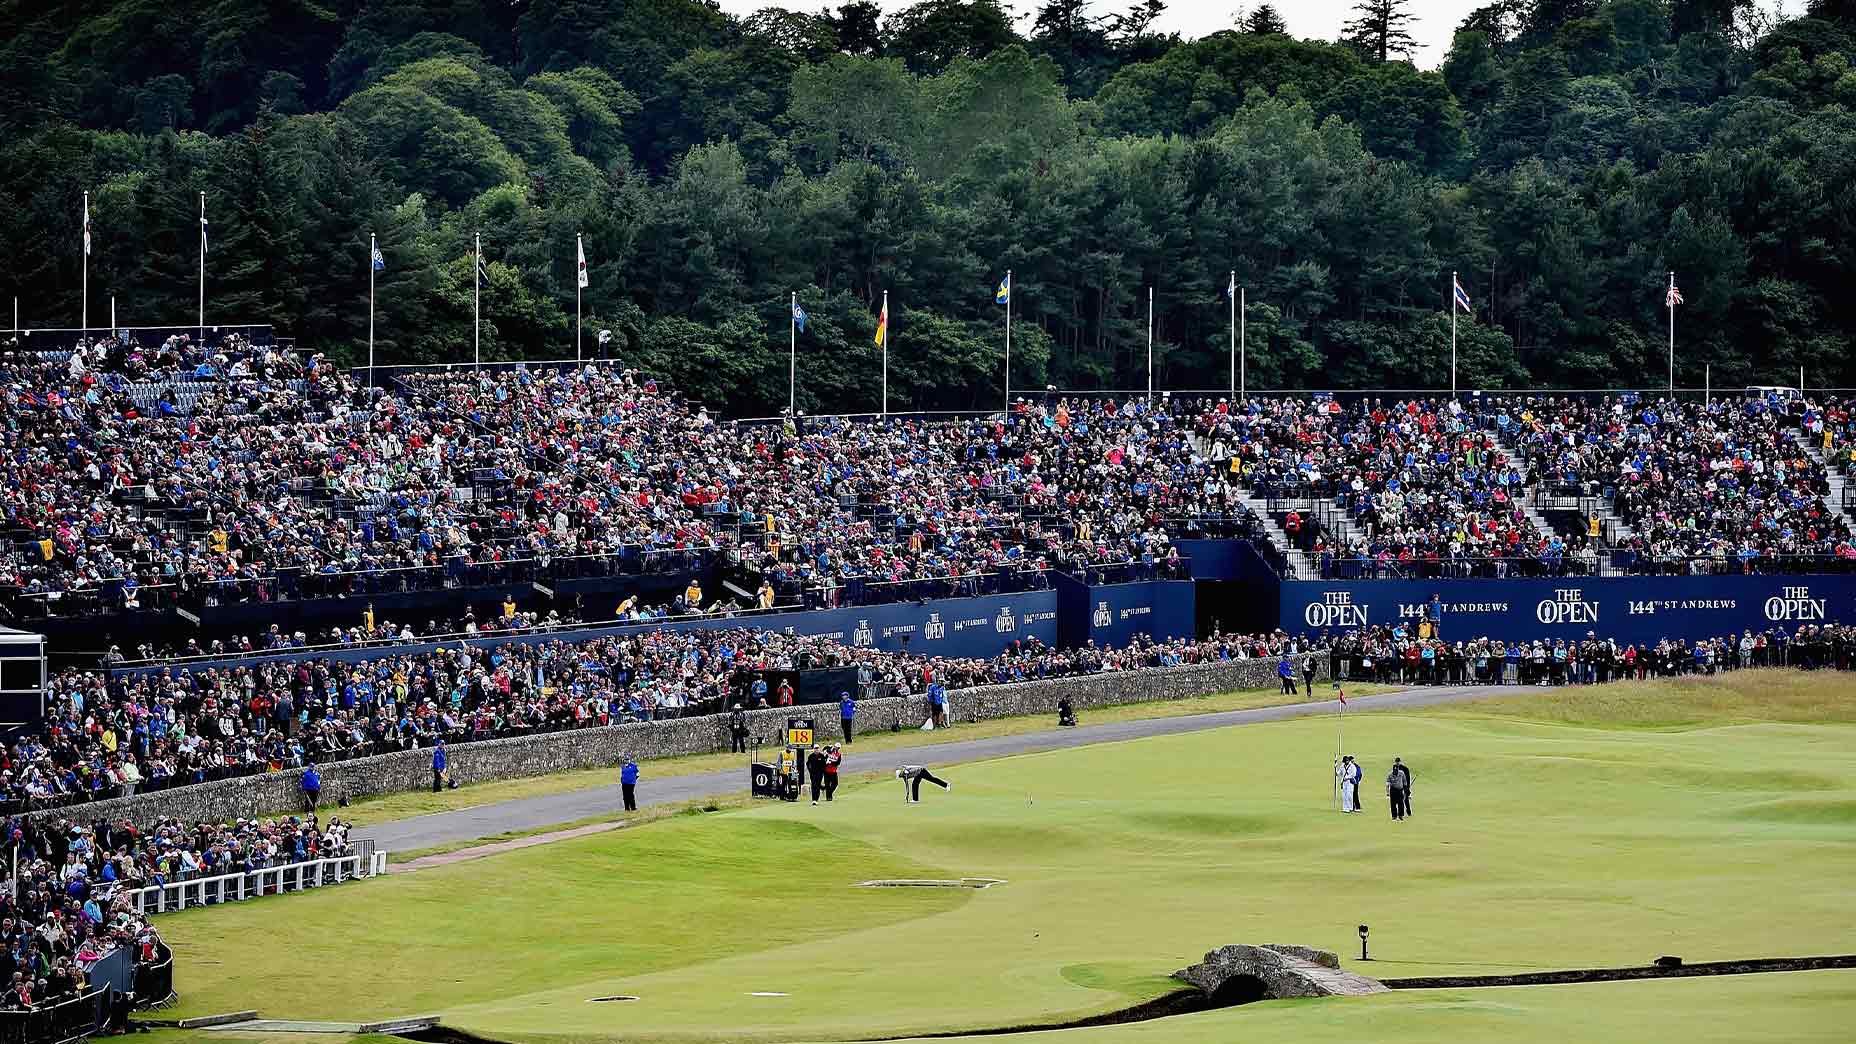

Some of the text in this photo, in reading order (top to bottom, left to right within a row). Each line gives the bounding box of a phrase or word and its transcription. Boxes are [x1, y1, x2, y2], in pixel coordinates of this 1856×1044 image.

[1323, 591, 1351, 605] THE
[1554, 588, 1582, 602] THE
[1782, 586, 1809, 599] THE
[1001, 606, 1011, 616] THE
[1451, 602, 1509, 613] ANDREWS
[1536, 599, 1600, 624] OPEN
[1664, 600, 1678, 609] ST
[1680, 600, 1736, 609] ANDREWS
[1764, 596, 1827, 621] OPEN
[1093, 609, 1112, 628] OPEN
[1305, 602, 1368, 627] OPEN
[859, 620, 868, 630] THE
[924, 621, 945, 640] OPEN
[996, 614, 1016, 633] OPEN
[853, 628, 873, 646] OPEN
[795, 730, 808, 744] 18
